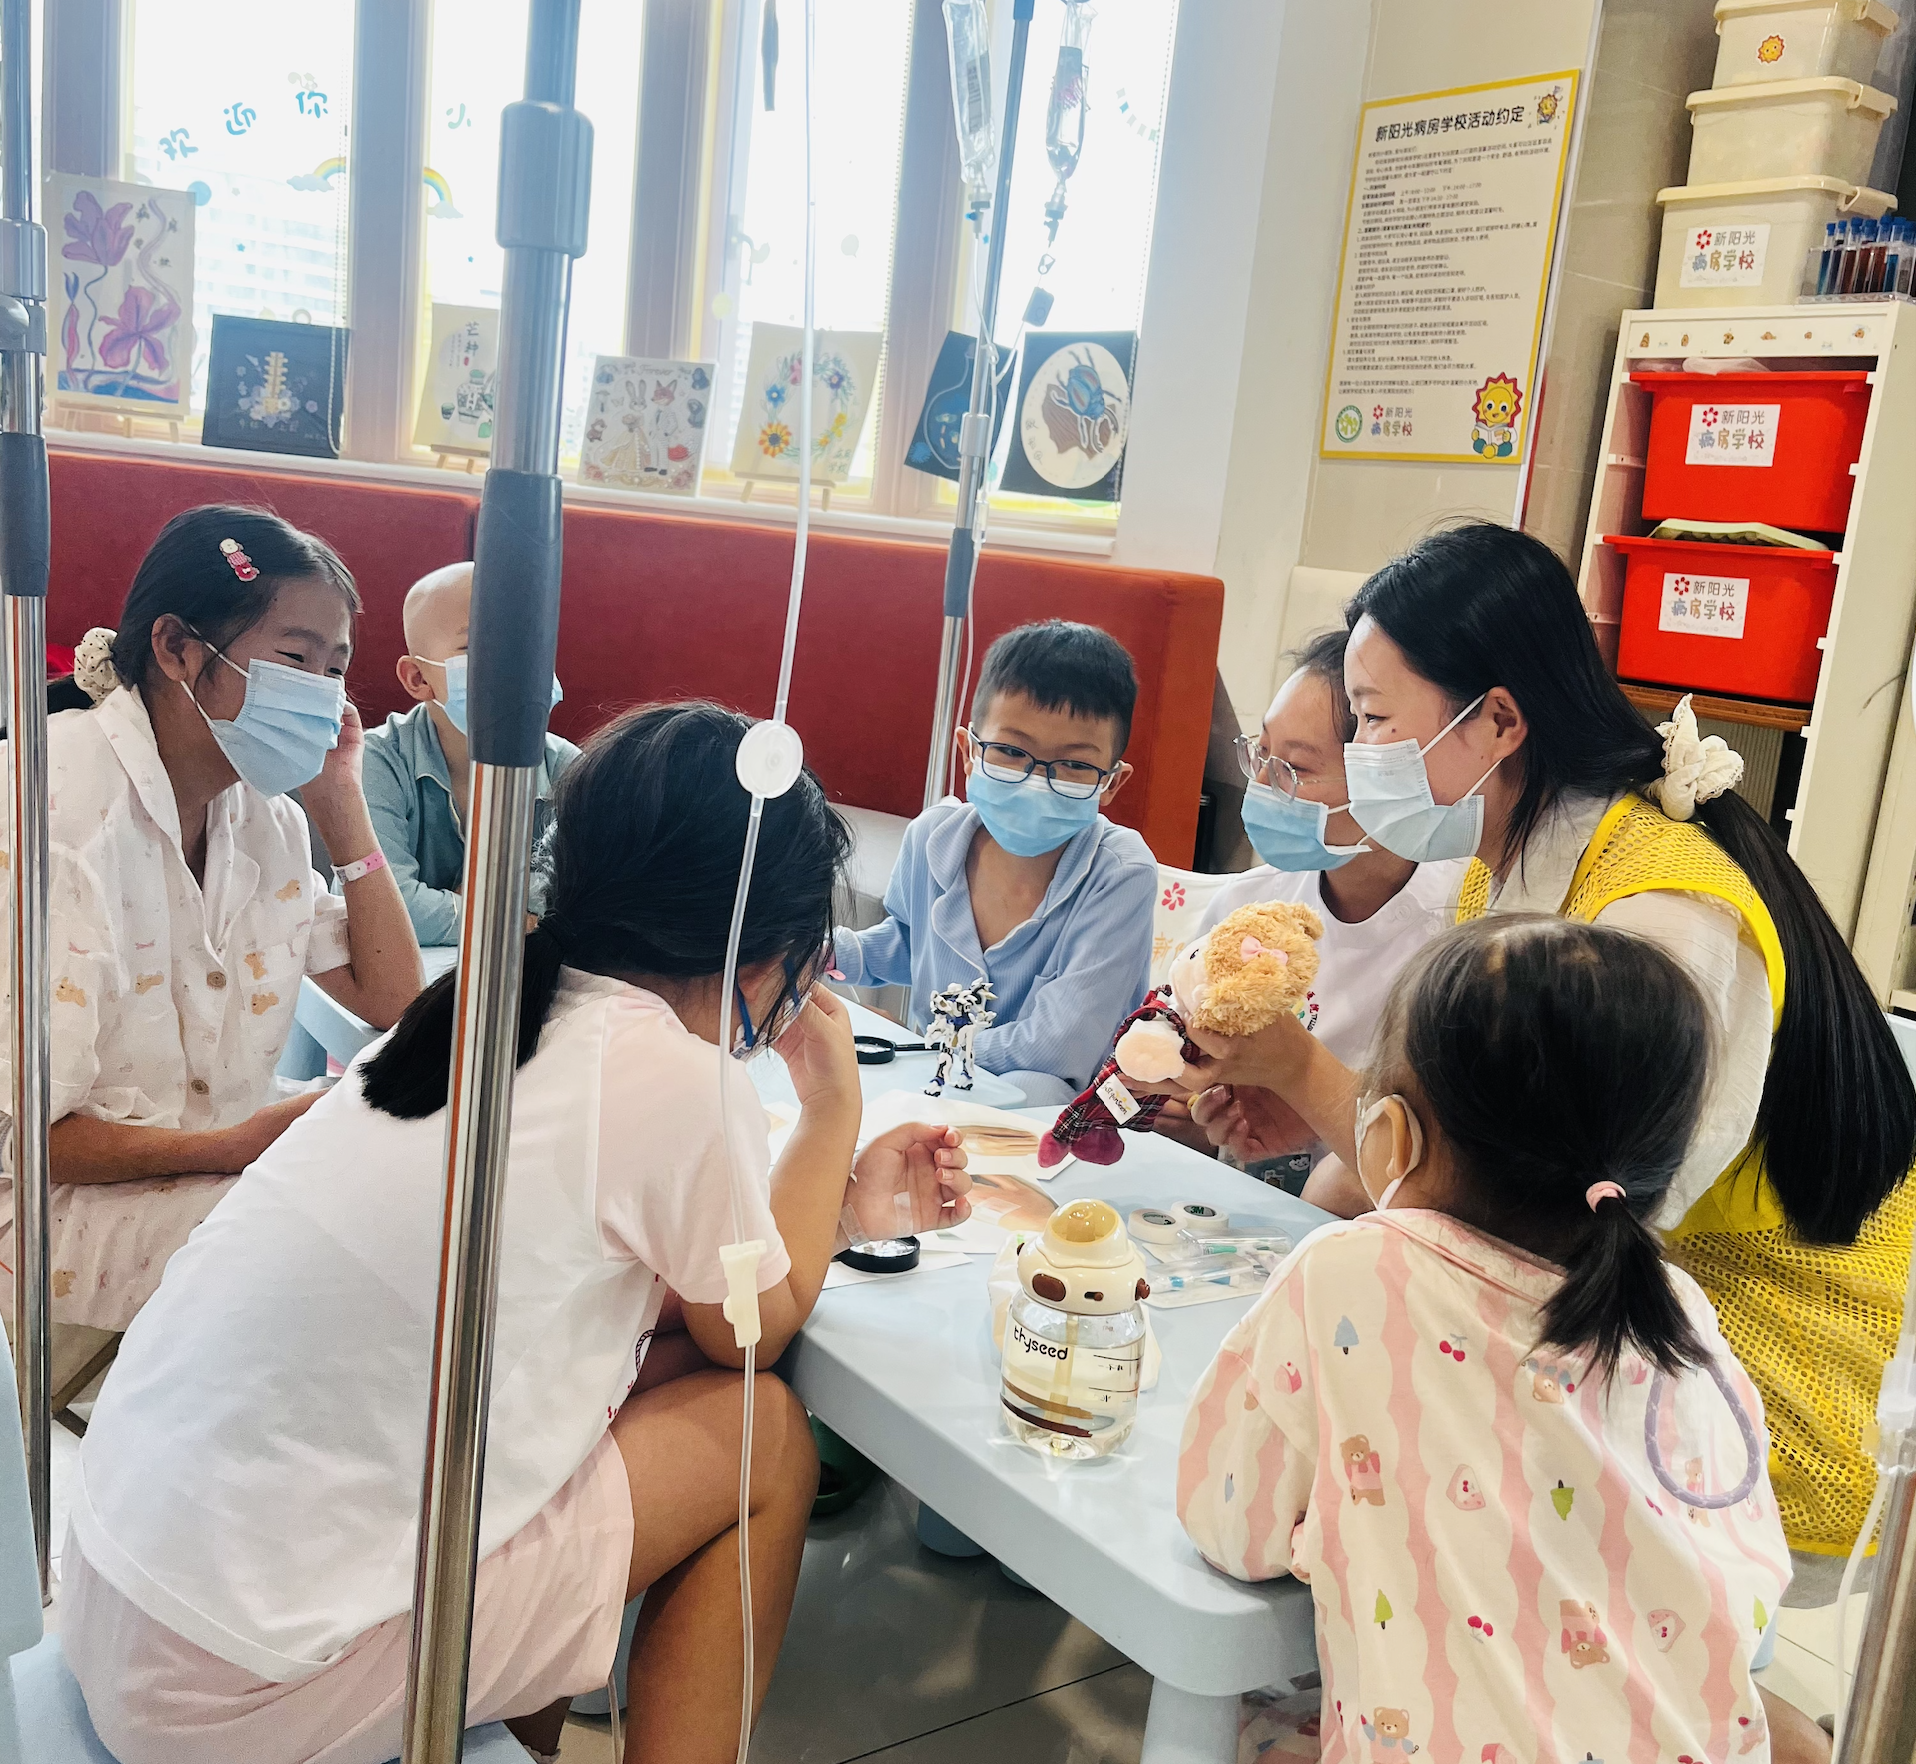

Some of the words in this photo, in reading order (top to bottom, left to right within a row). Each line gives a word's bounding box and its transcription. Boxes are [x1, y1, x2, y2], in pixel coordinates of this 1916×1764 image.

[1375, 105, 1525, 142] 新阳光病房学校活动约定
[1714, 230, 1755, 246] 新阳光
[1692, 249, 1755, 272] 病房学校
[1384, 406, 1413, 419] 新阳光
[1721, 410, 1765, 425] 新阳光
[1371, 420, 1413, 437] 病房学校
[1698, 427, 1765, 450] 病房学校
[1693, 580, 1735, 597] 新阳光
[1671, 597, 1735, 621] 病房学校
[1190, 1206, 1204, 1215] 3M
[1013, 1324, 1069, 1361] thyseed
